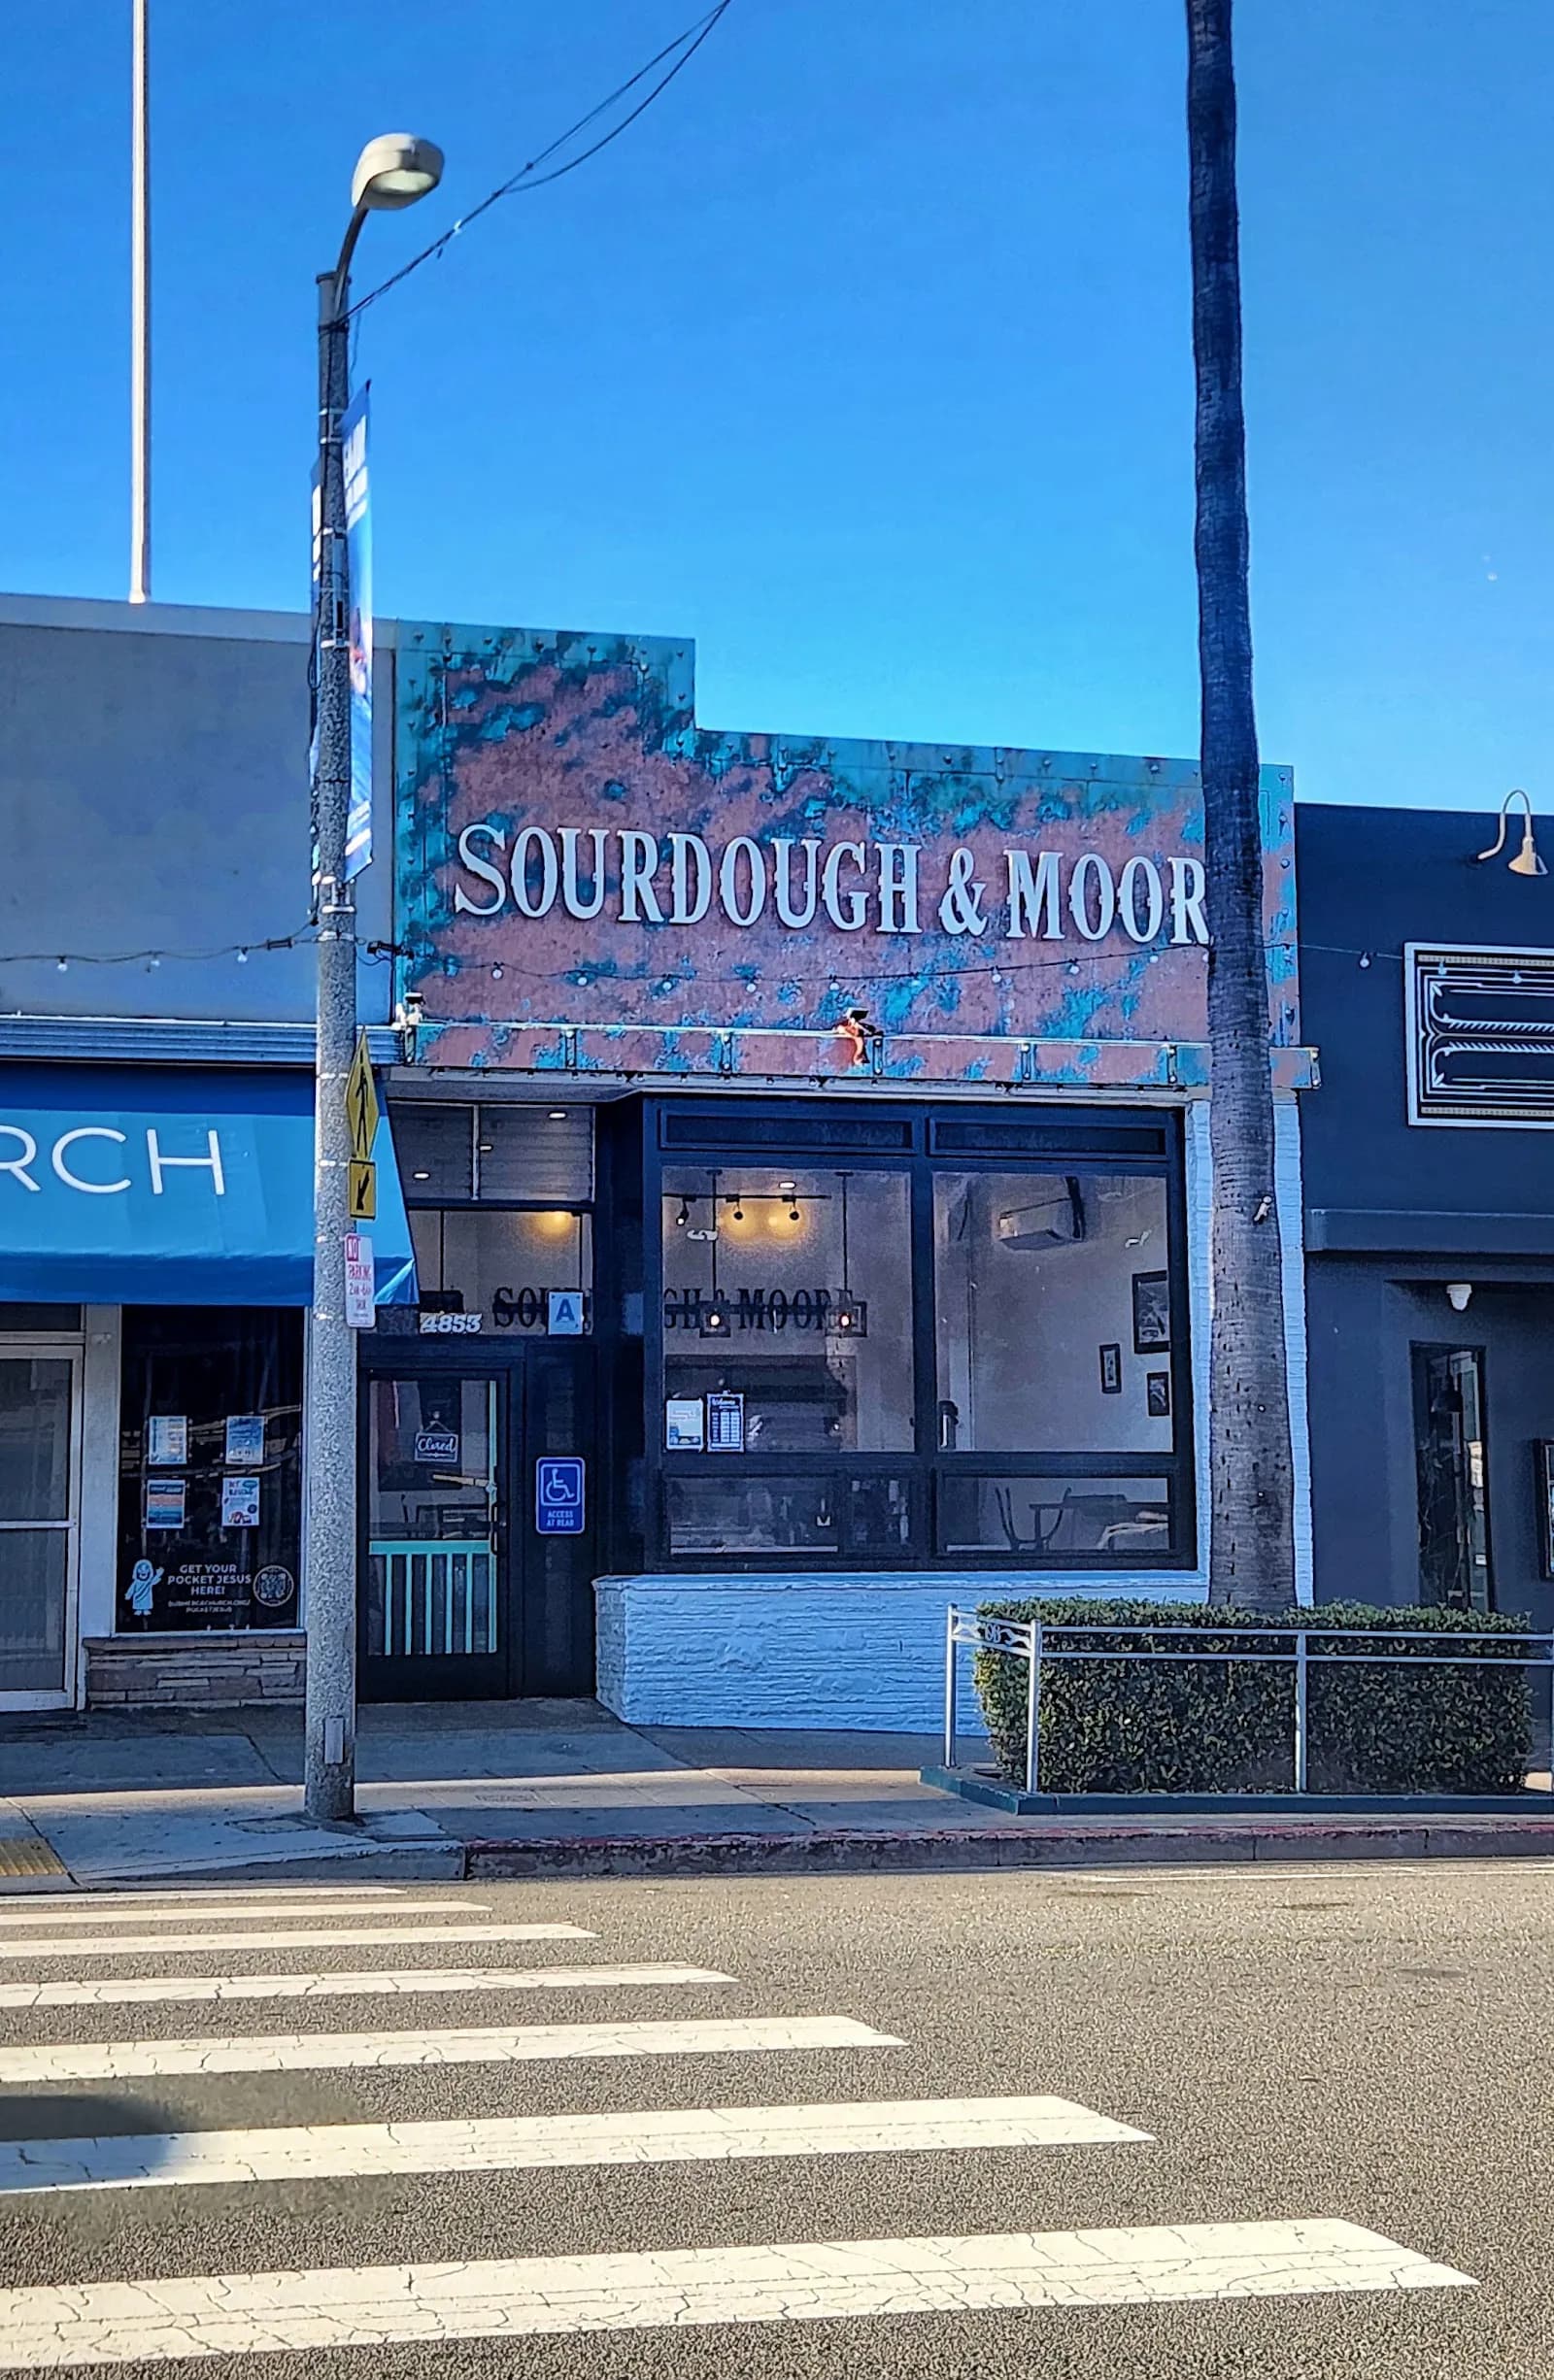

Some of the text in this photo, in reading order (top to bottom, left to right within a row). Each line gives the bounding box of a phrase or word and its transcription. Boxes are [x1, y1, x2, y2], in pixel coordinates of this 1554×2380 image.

[454, 823, 923, 935] SOURDOUGH
[939, 847, 990, 936] &
[1004, 849, 1210, 945] MOOR
[556, 1298, 575, 1322] A
[421, 1313, 483, 1333] 4853
[547, 1510, 574, 1519] ACCESS
[179, 1564, 237, 1574] GET YOUR
[167, 1574, 252, 1585] POCKET JESUS
[190, 1586, 226, 1595] HERE!
